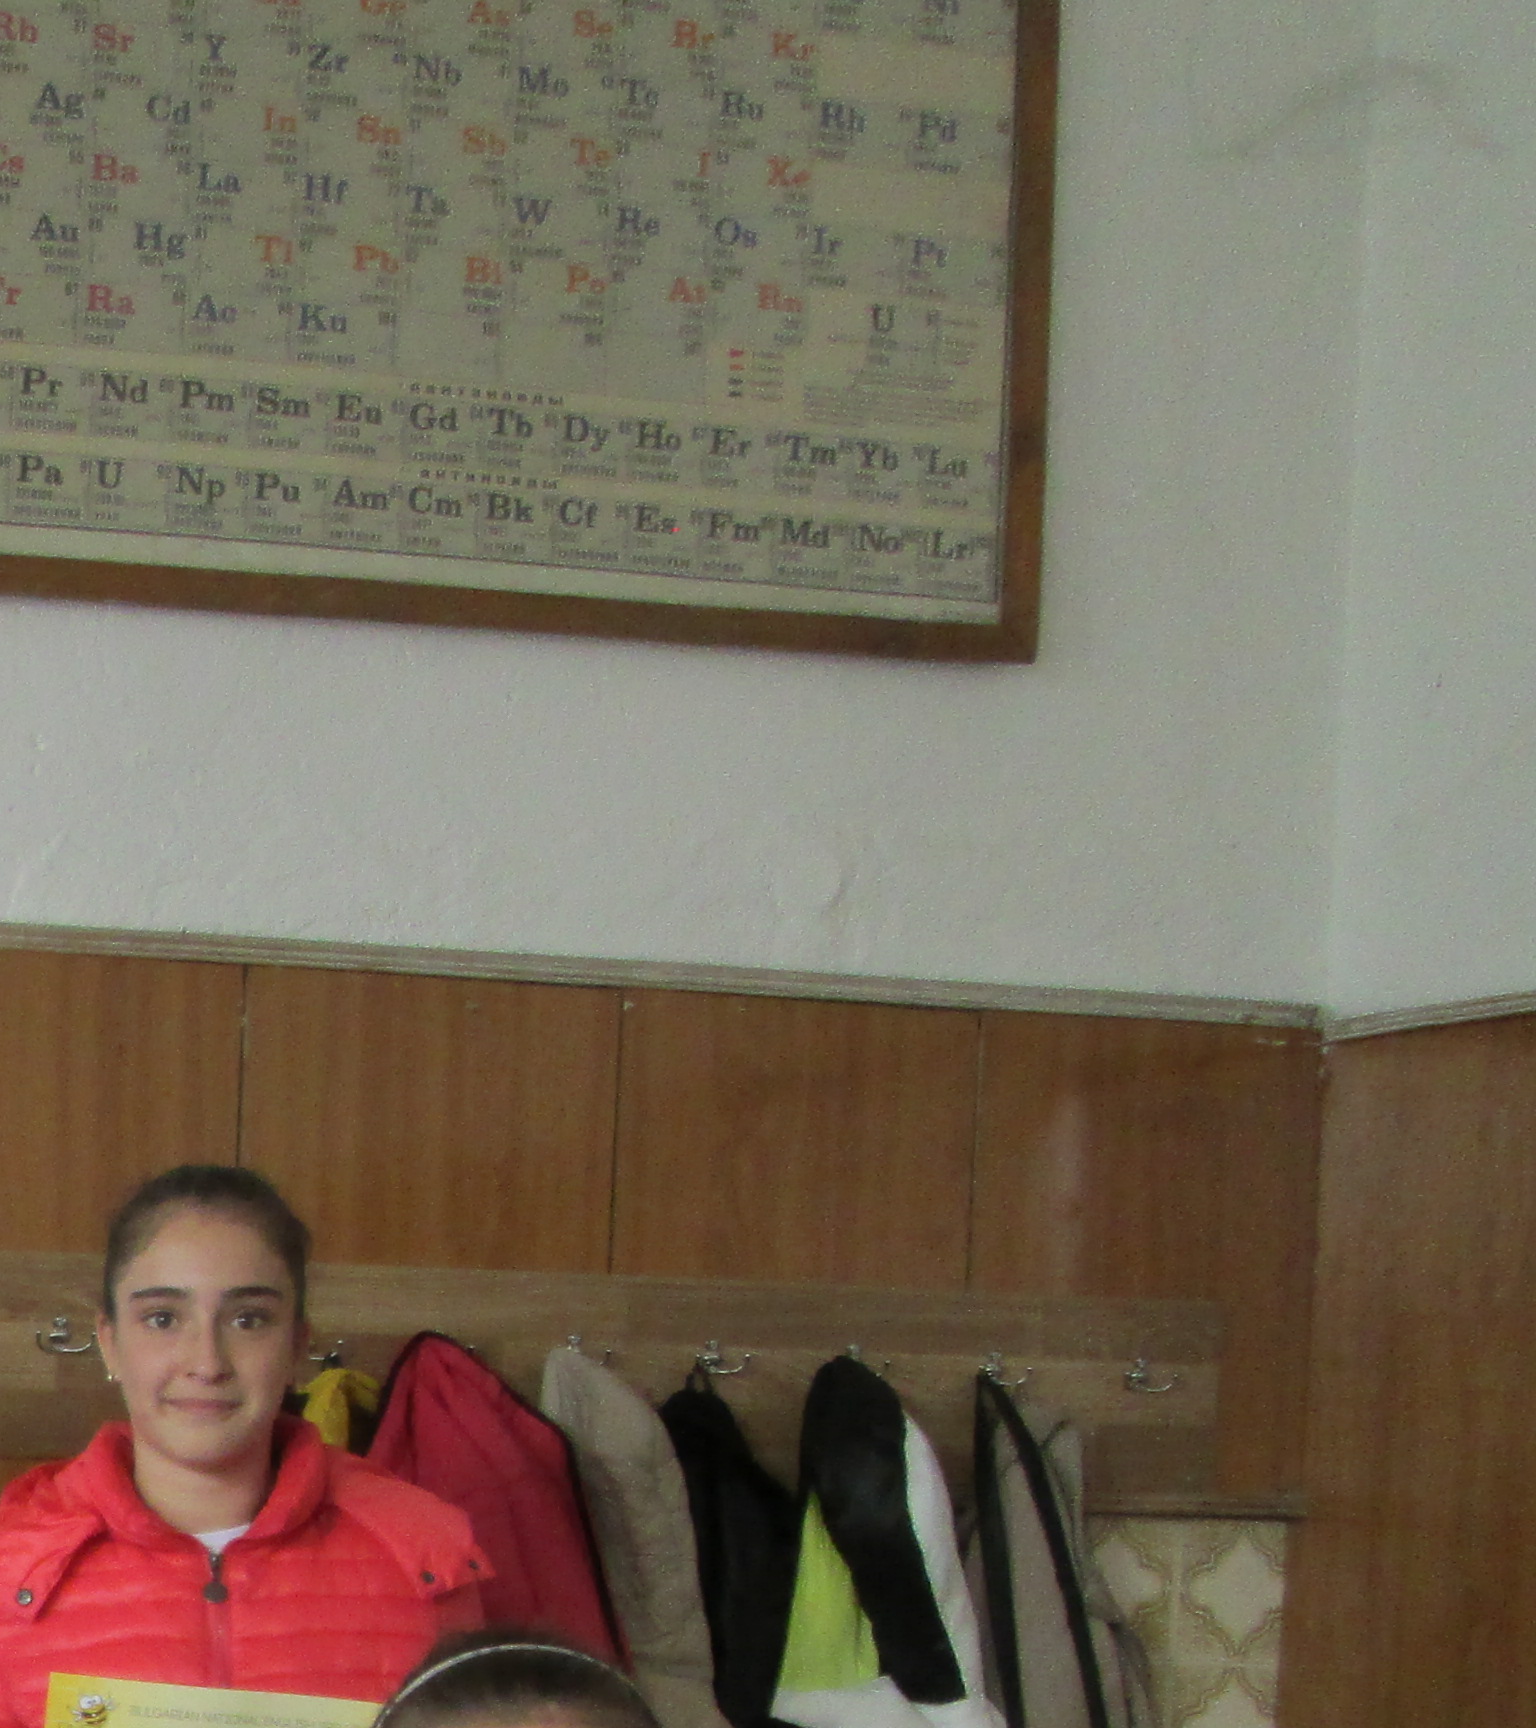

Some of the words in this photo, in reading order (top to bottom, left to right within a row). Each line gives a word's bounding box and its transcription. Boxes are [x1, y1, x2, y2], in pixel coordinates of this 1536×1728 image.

[21, 366, 64, 398] Pr
[100, 372, 149, 404] Nd
[181, 379, 235, 412] Pm
[409, 402, 459, 433] Gd
[16, 453, 64, 487] Pa
[97, 458, 126, 490] U
[175, 466, 226, 504] Np
[255, 473, 301, 503] Pu
[333, 480, 389, 511] Am
[409, 485, 463, 518] Cm
